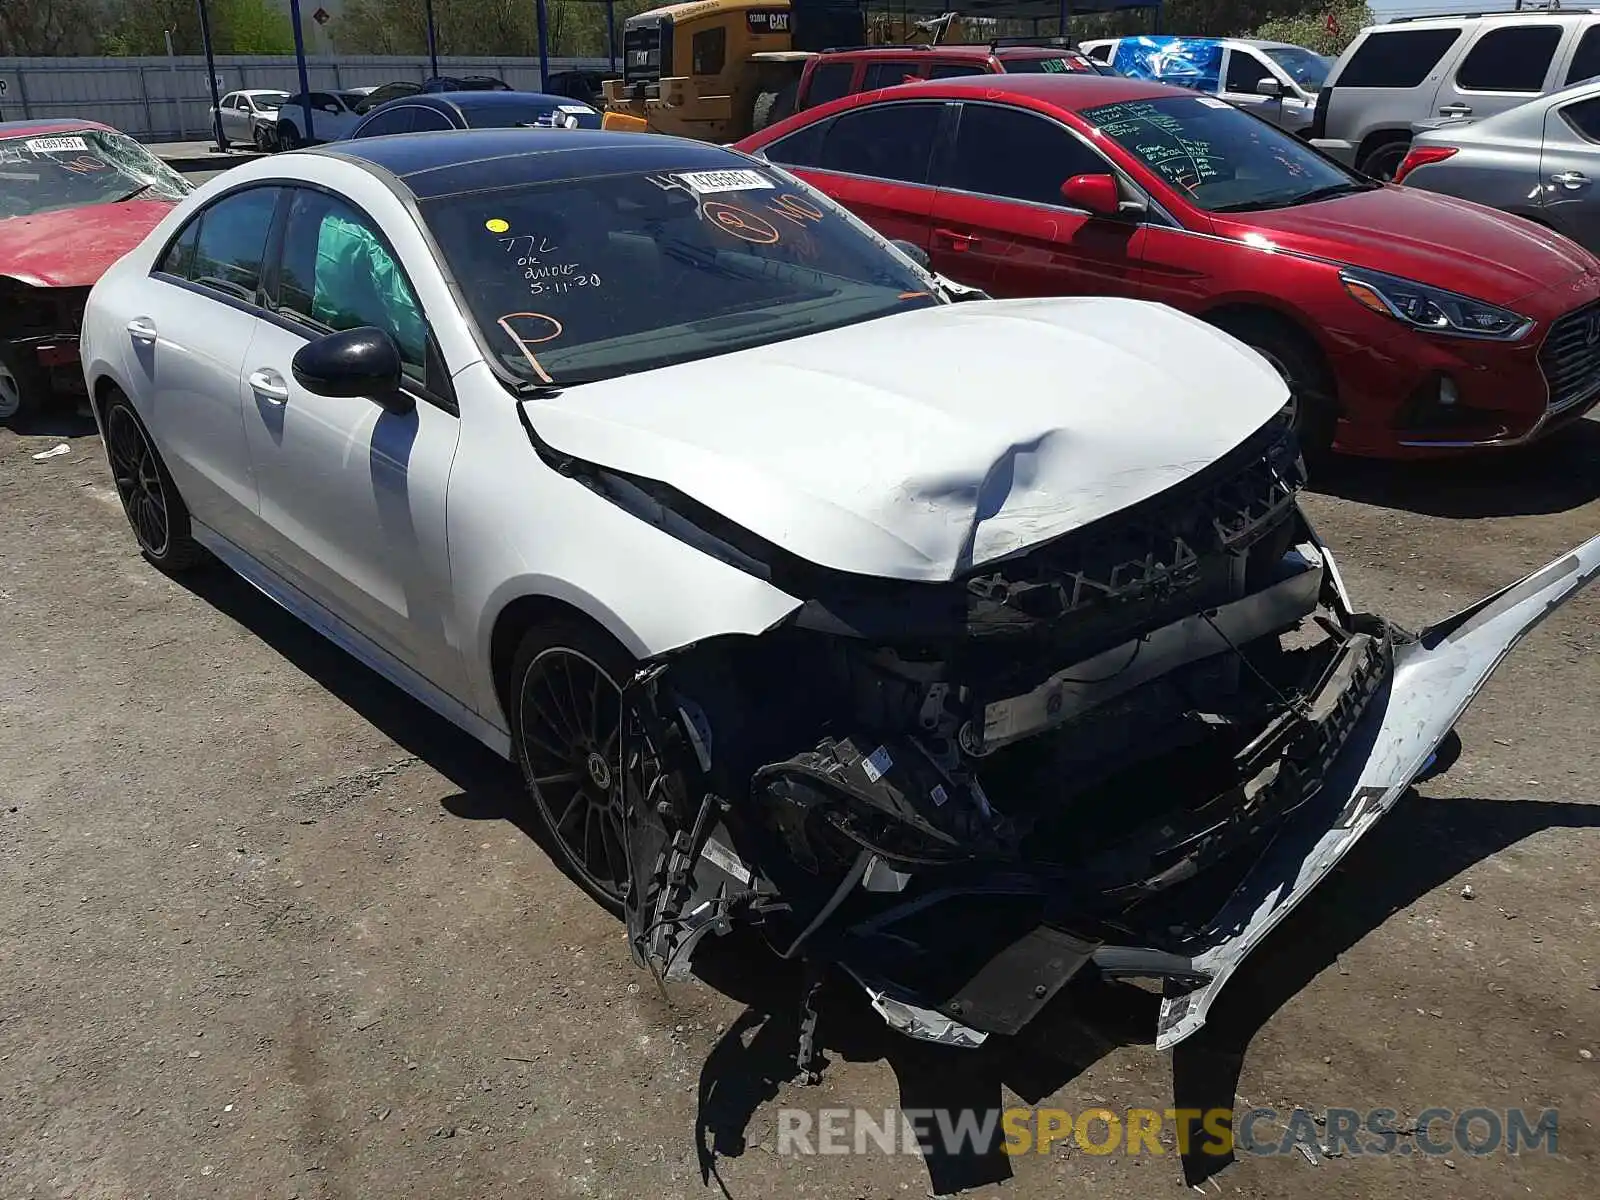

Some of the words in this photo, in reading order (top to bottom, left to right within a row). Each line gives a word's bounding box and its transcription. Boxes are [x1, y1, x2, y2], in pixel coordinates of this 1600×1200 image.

[769, 13, 789, 30] CAT
[636, 50, 649, 65] CAT
[497, 312, 563, 384] P
